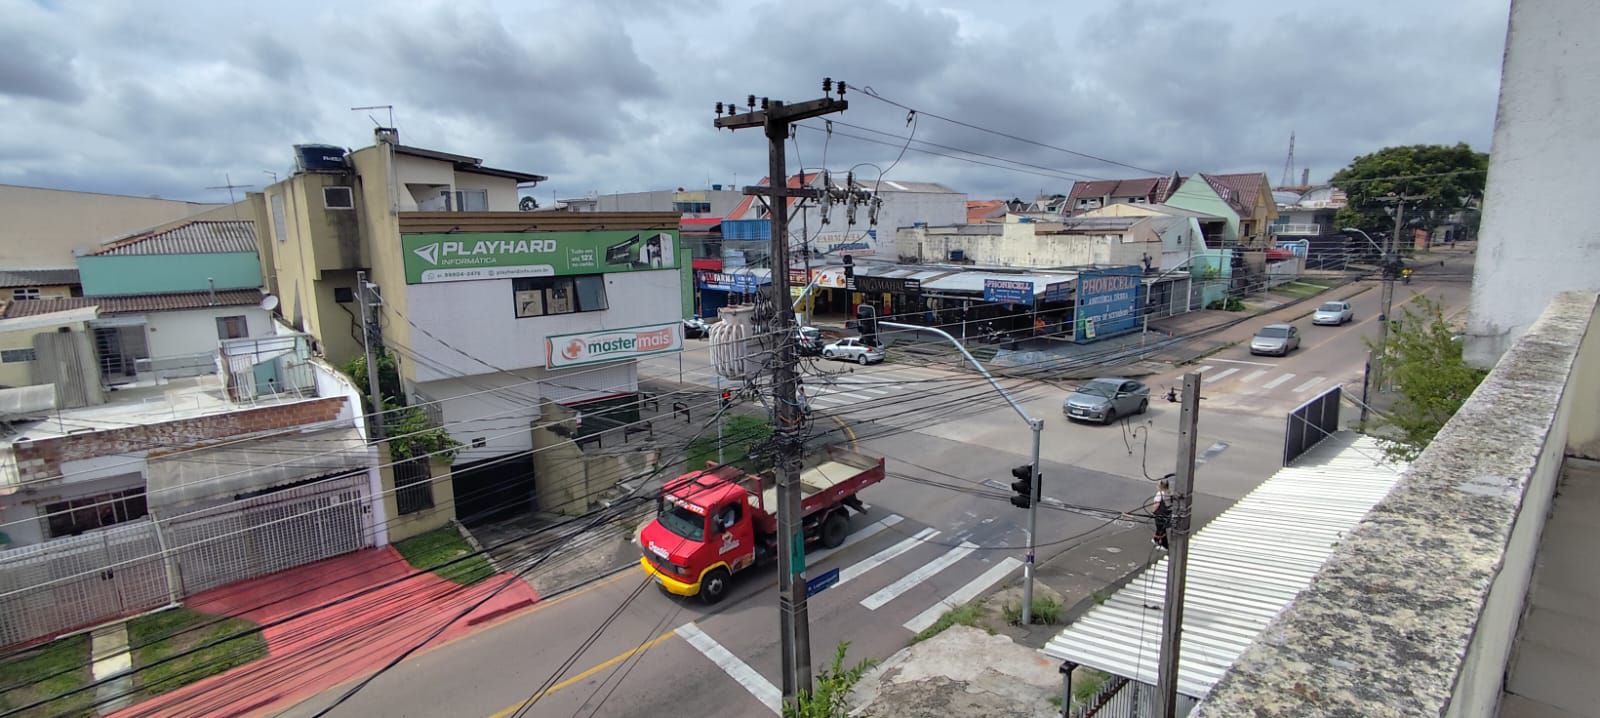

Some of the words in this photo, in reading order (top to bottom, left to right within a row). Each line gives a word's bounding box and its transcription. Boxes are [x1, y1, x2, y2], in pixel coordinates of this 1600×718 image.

[442, 239, 557, 256] PLAYHARD
[441, 256, 497, 265] INFORMÁTICA
[1081, 276, 1136, 296] PHONECELL
